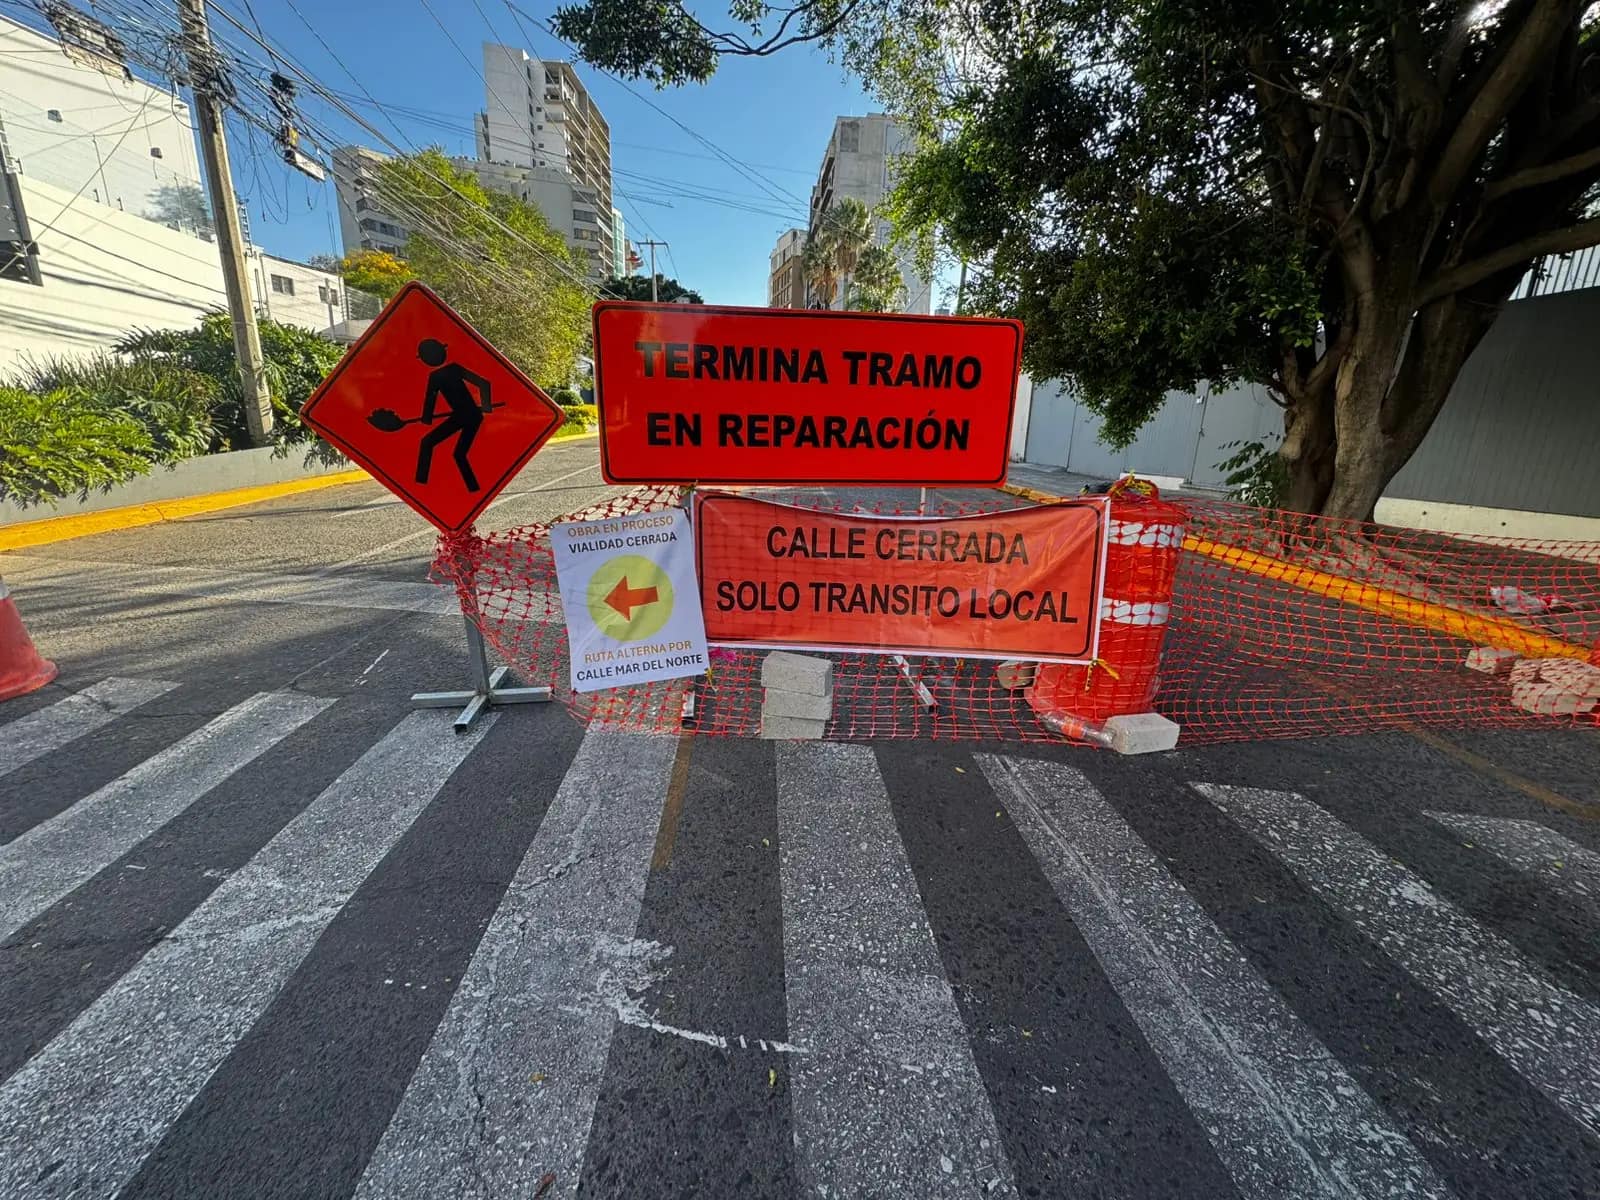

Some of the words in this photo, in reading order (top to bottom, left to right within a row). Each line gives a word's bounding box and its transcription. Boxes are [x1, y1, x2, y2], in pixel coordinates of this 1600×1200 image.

[634, 341, 828, 385] TERMINA
[842, 351, 982, 390] TRAMO
[647, 412, 702, 447] EN
[718, 409, 970, 451] REPARACIÓN
[567, 525, 600, 538] OBRA
[603, 522, 618, 533] EN
[621, 515, 673, 531] PROCESO
[569, 538, 624, 554] VIALIDAD
[626, 531, 677, 547] CERRADA
[766, 525, 865, 559] CALLE
[875, 528, 1029, 565] CERRADA
[716, 580, 800, 612] SOLO
[809, 581, 960, 618] TRANSITO
[969, 587, 1079, 624] LOCAL
[576, 666, 613, 681] CALLE
[615, 661, 640, 675] MAR
[642, 658, 663, 670] DEL
[665, 654, 703, 668] NORTE
[584, 650, 615, 664] RUTA
[617, 644, 667, 660] ALTERNA
[669, 640, 692, 651] POR
